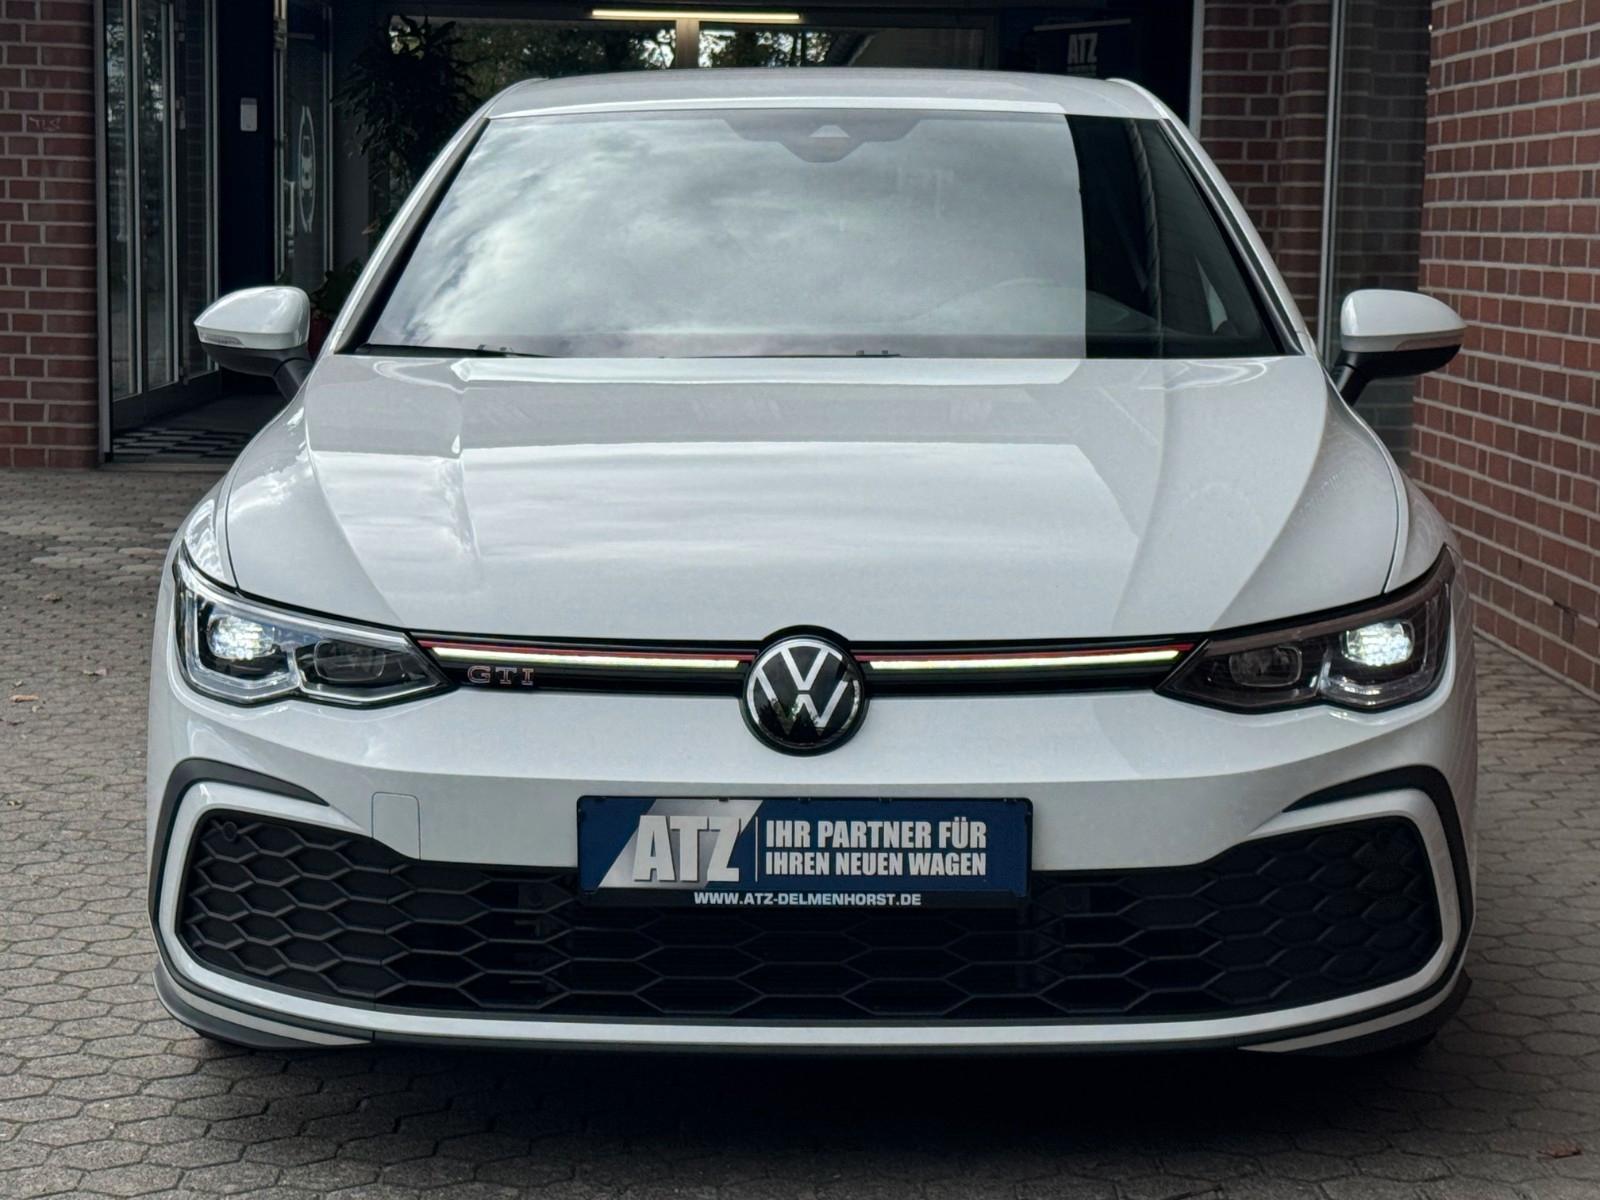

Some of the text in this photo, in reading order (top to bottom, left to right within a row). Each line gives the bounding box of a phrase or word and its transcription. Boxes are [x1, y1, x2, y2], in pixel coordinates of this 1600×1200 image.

[1066, 32, 1098, 64] ATZ
[467, 665, 535, 686] GTI
[766, 816, 987, 849] IHR PARTNER FÜR
[632, 815, 741, 882] ATZ
[765, 852, 986, 876] IHREN NEUEN WAGEN
[693, 891, 922, 906] WWW.ATZ-DELMENHORST.DE
